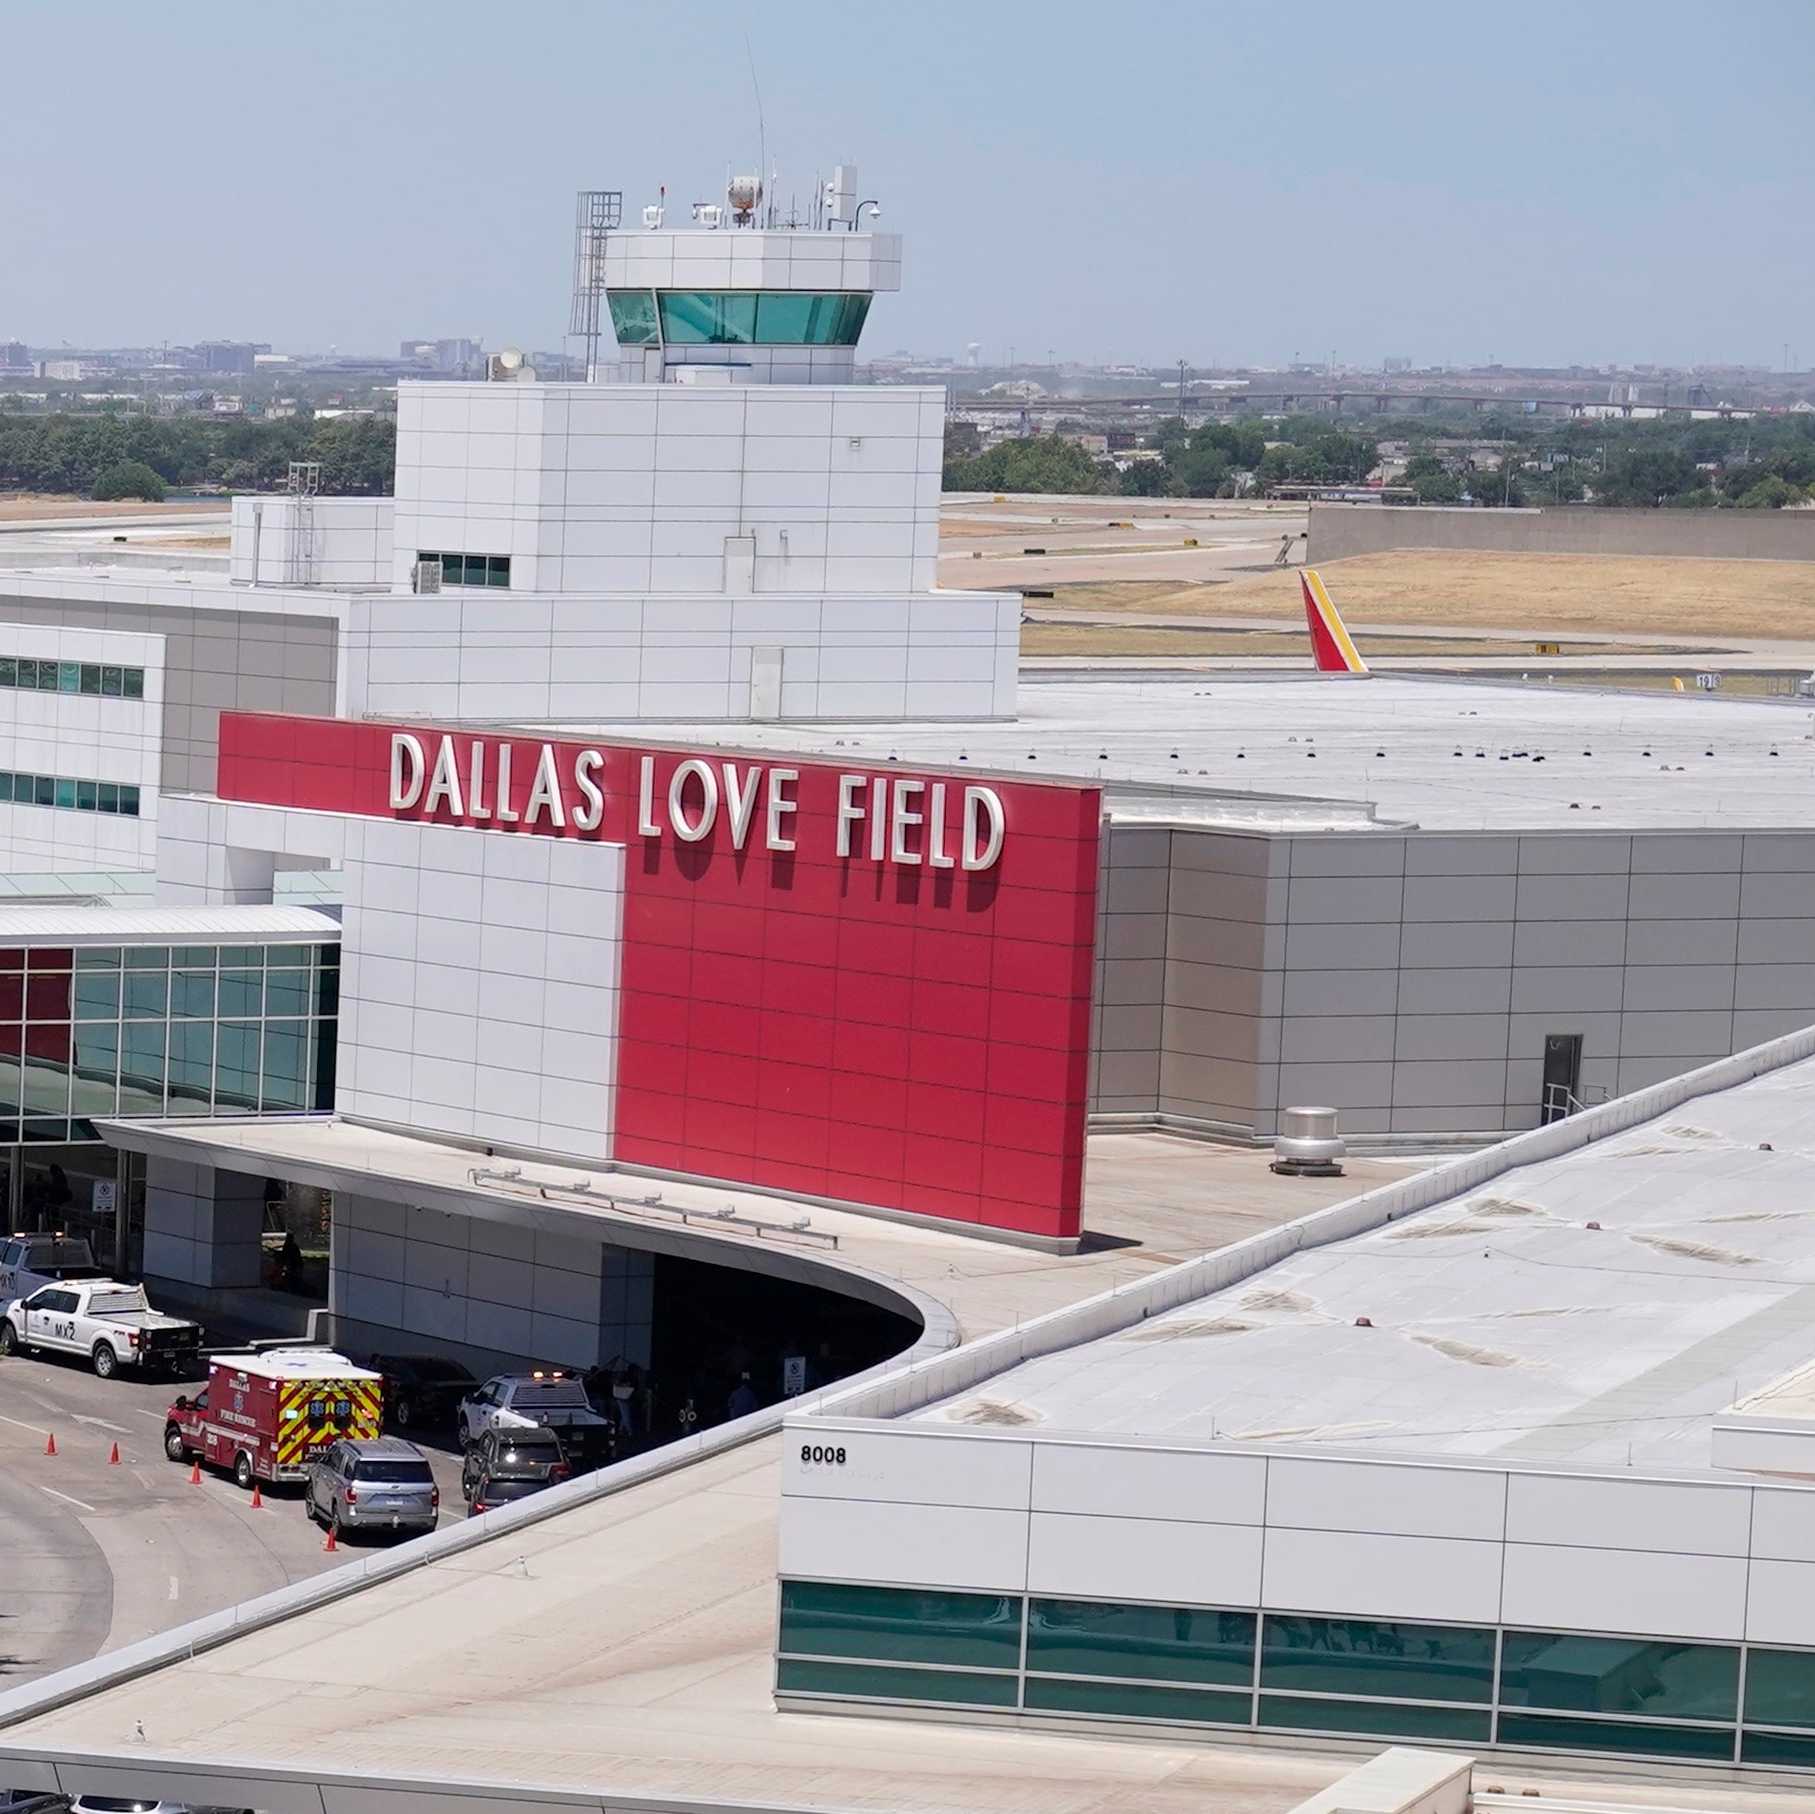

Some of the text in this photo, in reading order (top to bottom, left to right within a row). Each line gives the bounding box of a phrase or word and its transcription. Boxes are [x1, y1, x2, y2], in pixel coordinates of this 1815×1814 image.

[387, 733, 1006, 872] DALLAS LOVE FIELD
[801, 1446, 846, 1464] 8008
